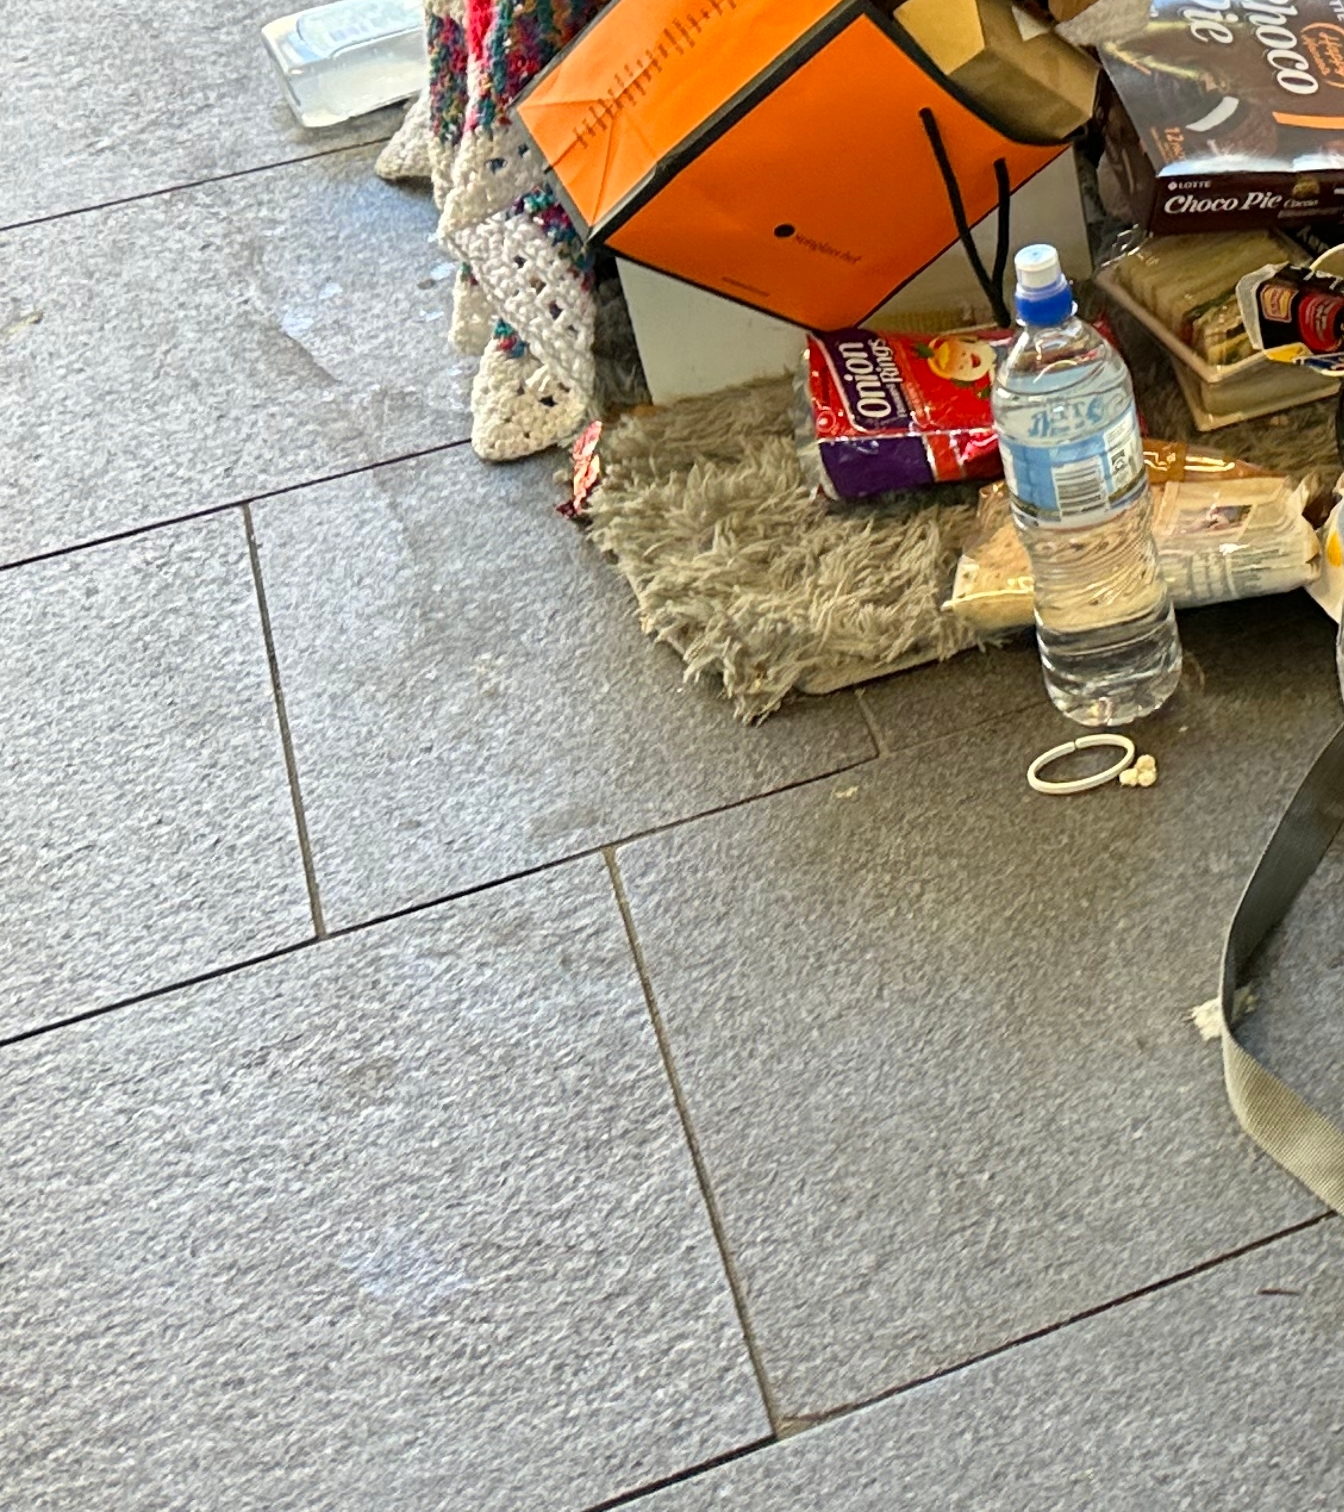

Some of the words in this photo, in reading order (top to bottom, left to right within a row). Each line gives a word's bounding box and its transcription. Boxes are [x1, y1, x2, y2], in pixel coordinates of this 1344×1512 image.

[1178, 180, 1211, 189] LOTTE
[1164, 194, 1239, 214] Choco
[1241, 191, 1283, 211] Pie
[868, 338, 903, 383] Rings
[839, 342, 891, 417] Onion
